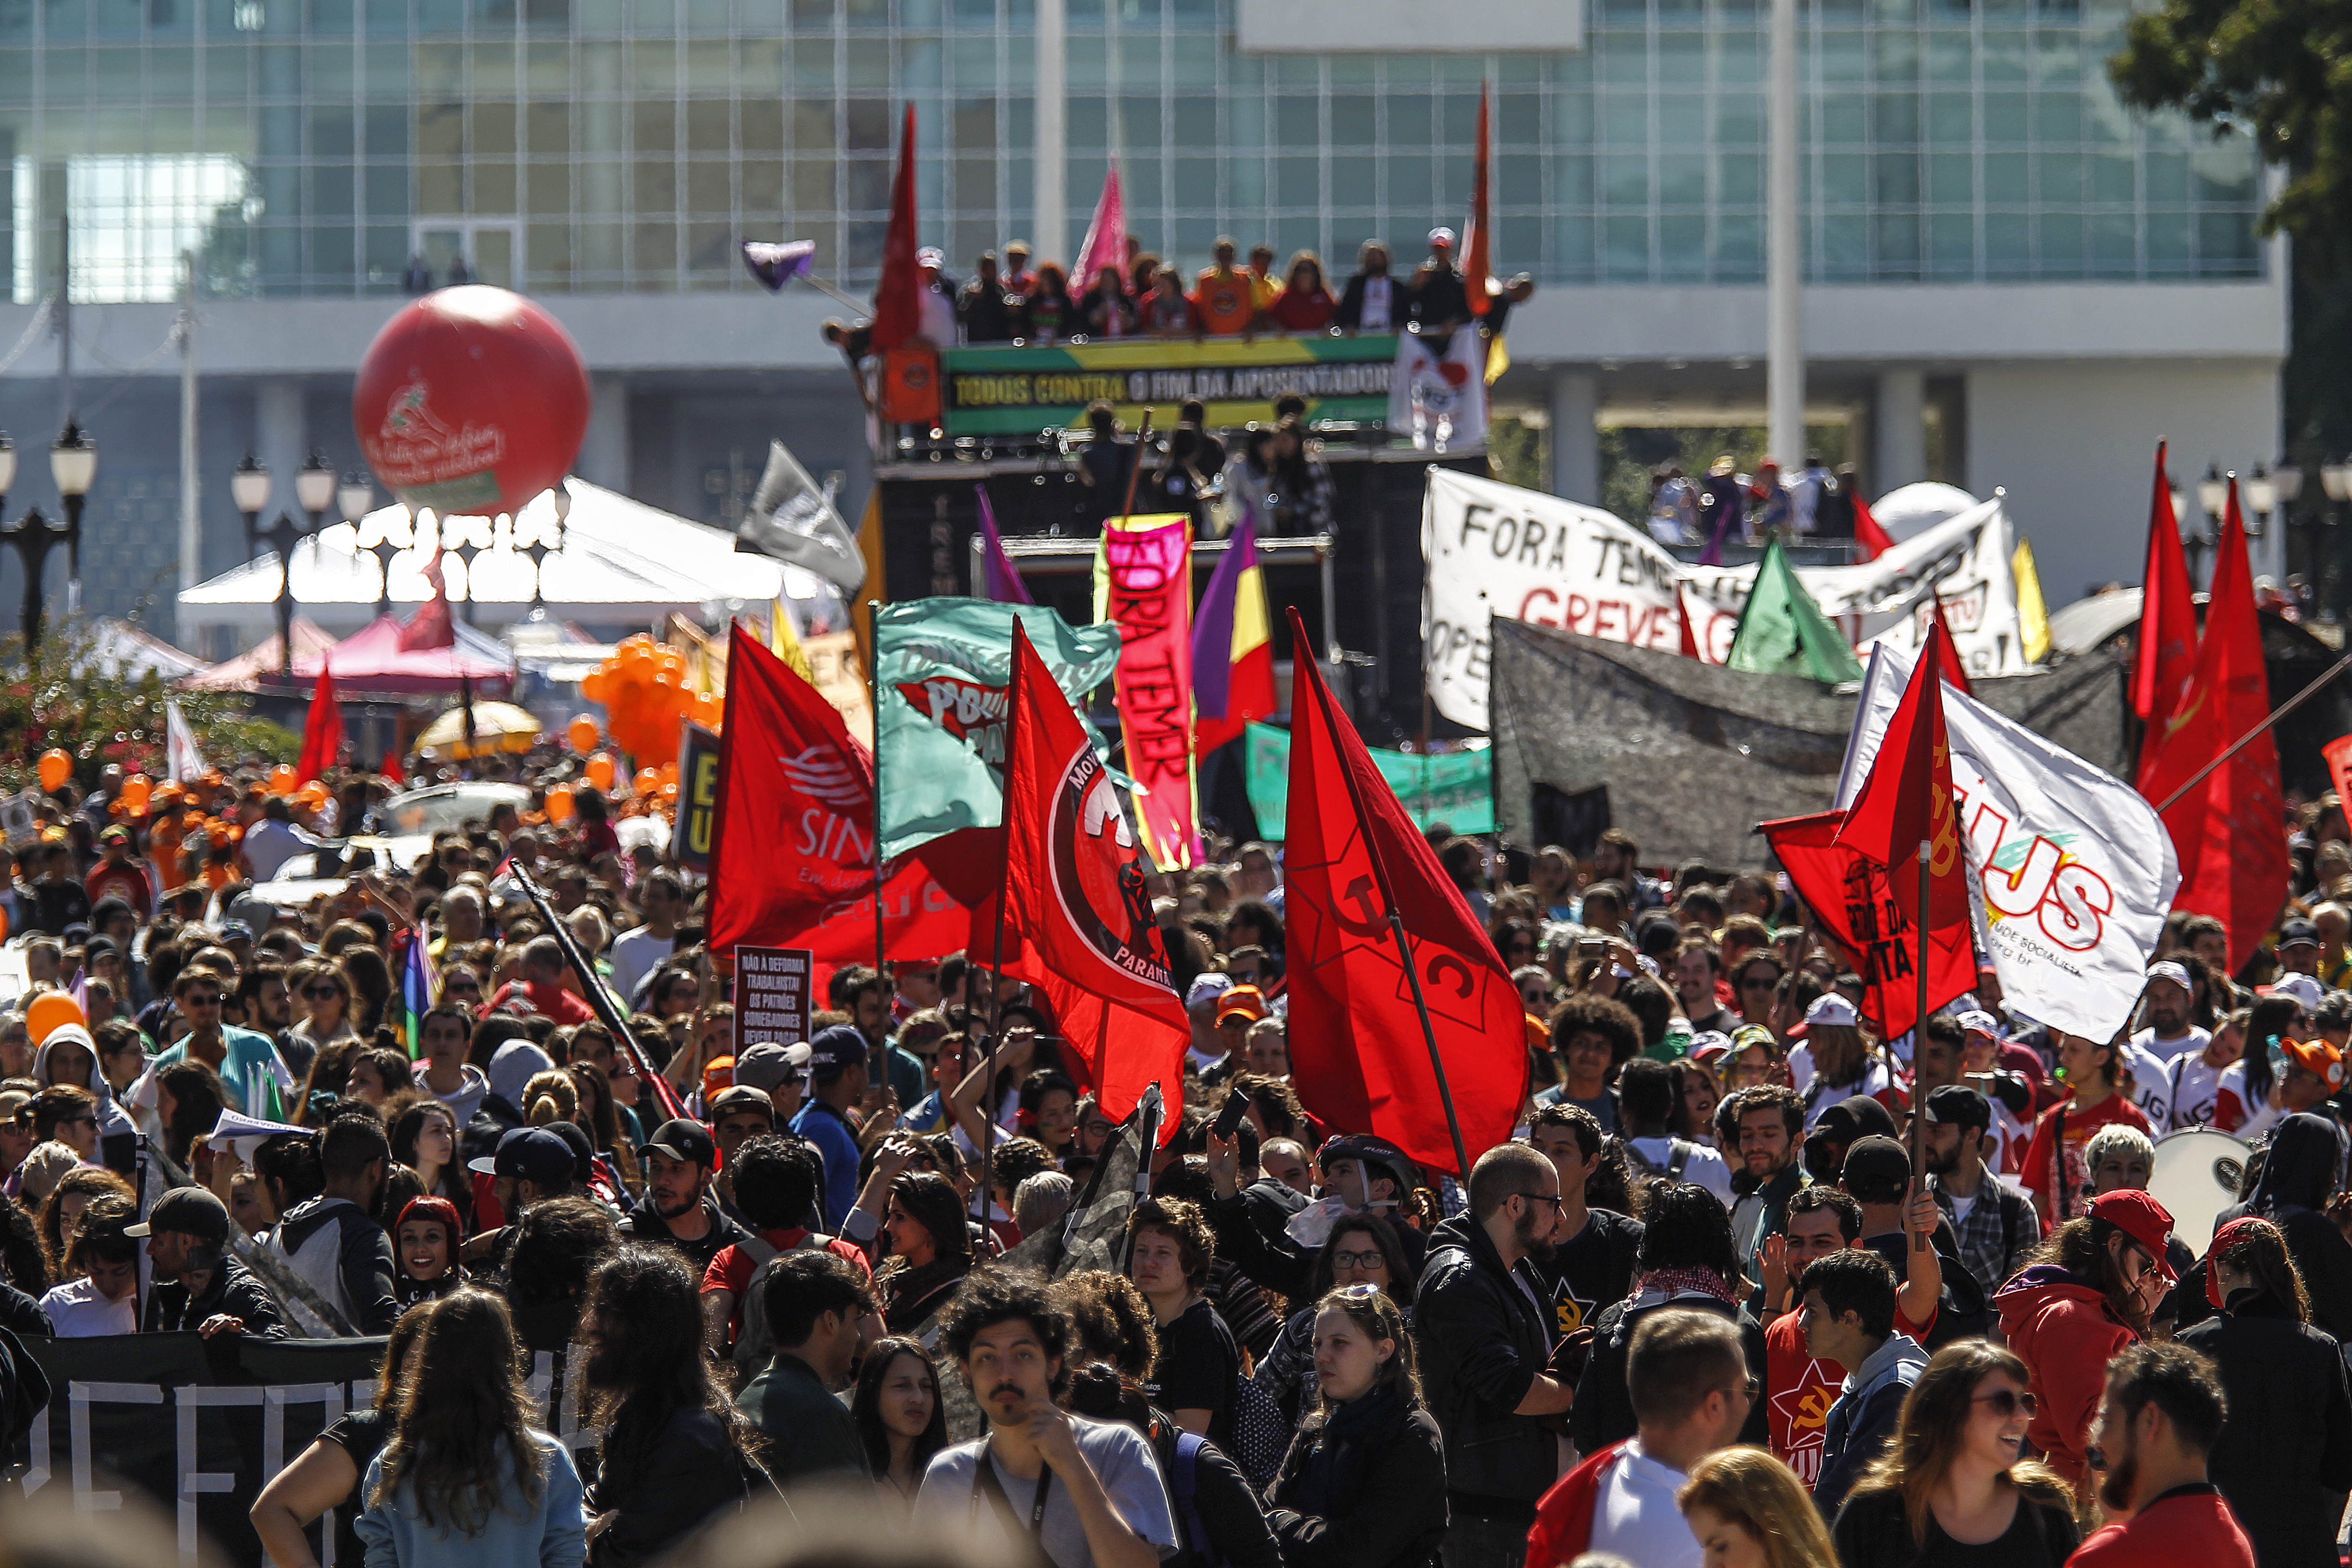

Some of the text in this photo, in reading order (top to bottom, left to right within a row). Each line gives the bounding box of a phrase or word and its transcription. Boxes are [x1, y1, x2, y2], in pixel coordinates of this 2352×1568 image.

[956, 373, 1033, 405] TODOS
[1034, 373, 1126, 404] CONTRA
[1128, 371, 1149, 402] O
[1151, 368, 1192, 400] FIM
[1195, 367, 1228, 399] DA
[1459, 503, 1568, 571] FORA
[1519, 588, 1673, 648] GREVE
[1108, 534, 1188, 784] FORA TEMER
[742, 954, 805, 973] NÃO À DEFORMA
[749, 992, 796, 1010] OS PATRÕES
[744, 1010, 801, 1029] SONEGADORES
[1363, 1146, 1394, 1155] RUDY
